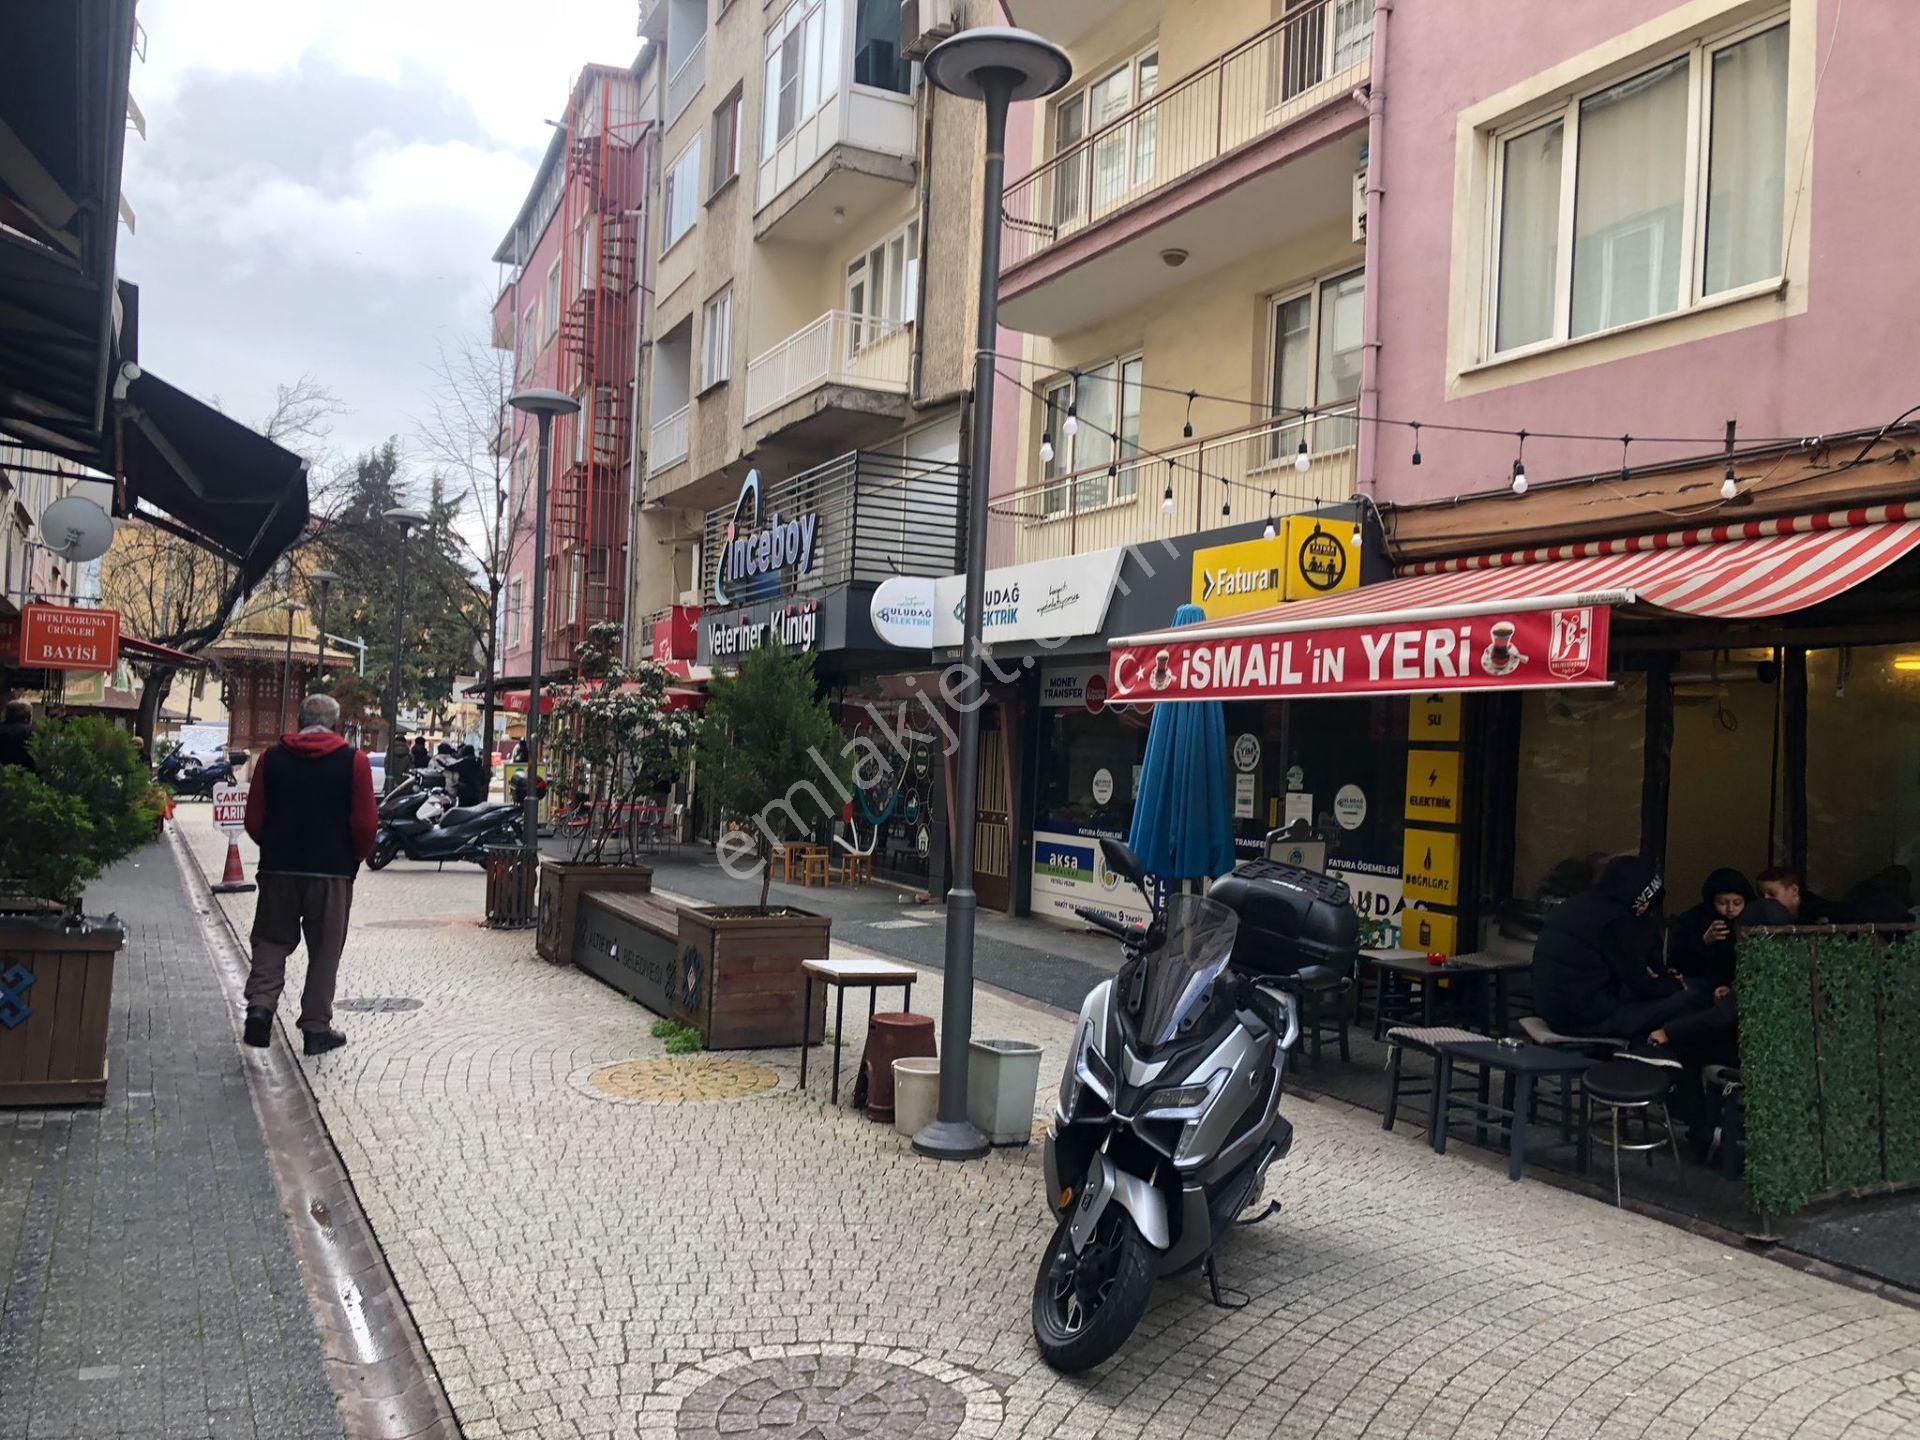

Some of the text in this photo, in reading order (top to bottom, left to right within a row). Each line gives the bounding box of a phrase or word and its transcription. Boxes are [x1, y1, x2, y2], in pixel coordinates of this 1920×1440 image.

[727, 513, 819, 582] inceboy
[1216, 567, 1279, 596] Faturan
[985, 582, 1020, 606] UDAĞ
[36, 613, 106, 627] BİTKİ KORUMA
[708, 614, 766, 656] Veteriner
[770, 599, 817, 652] Kliniği
[47, 624, 95, 637] ÜRÜNLERİ
[43, 645, 97, 661] BAYİSİ
[1049, 677, 1078, 688] MONEY
[1044, 688, 1083, 699] TRANSFER
[1427, 714, 1442, 726] SU
[1409, 795, 1451, 809] ELEKTRİK
[1049, 852, 1078, 869] aksa
[1328, 858, 1400, 875] FATURA ÖDEMELERİ
[1405, 874, 1449, 891] DOĞALGAZ
[1118, 910, 1124, 922] 9
